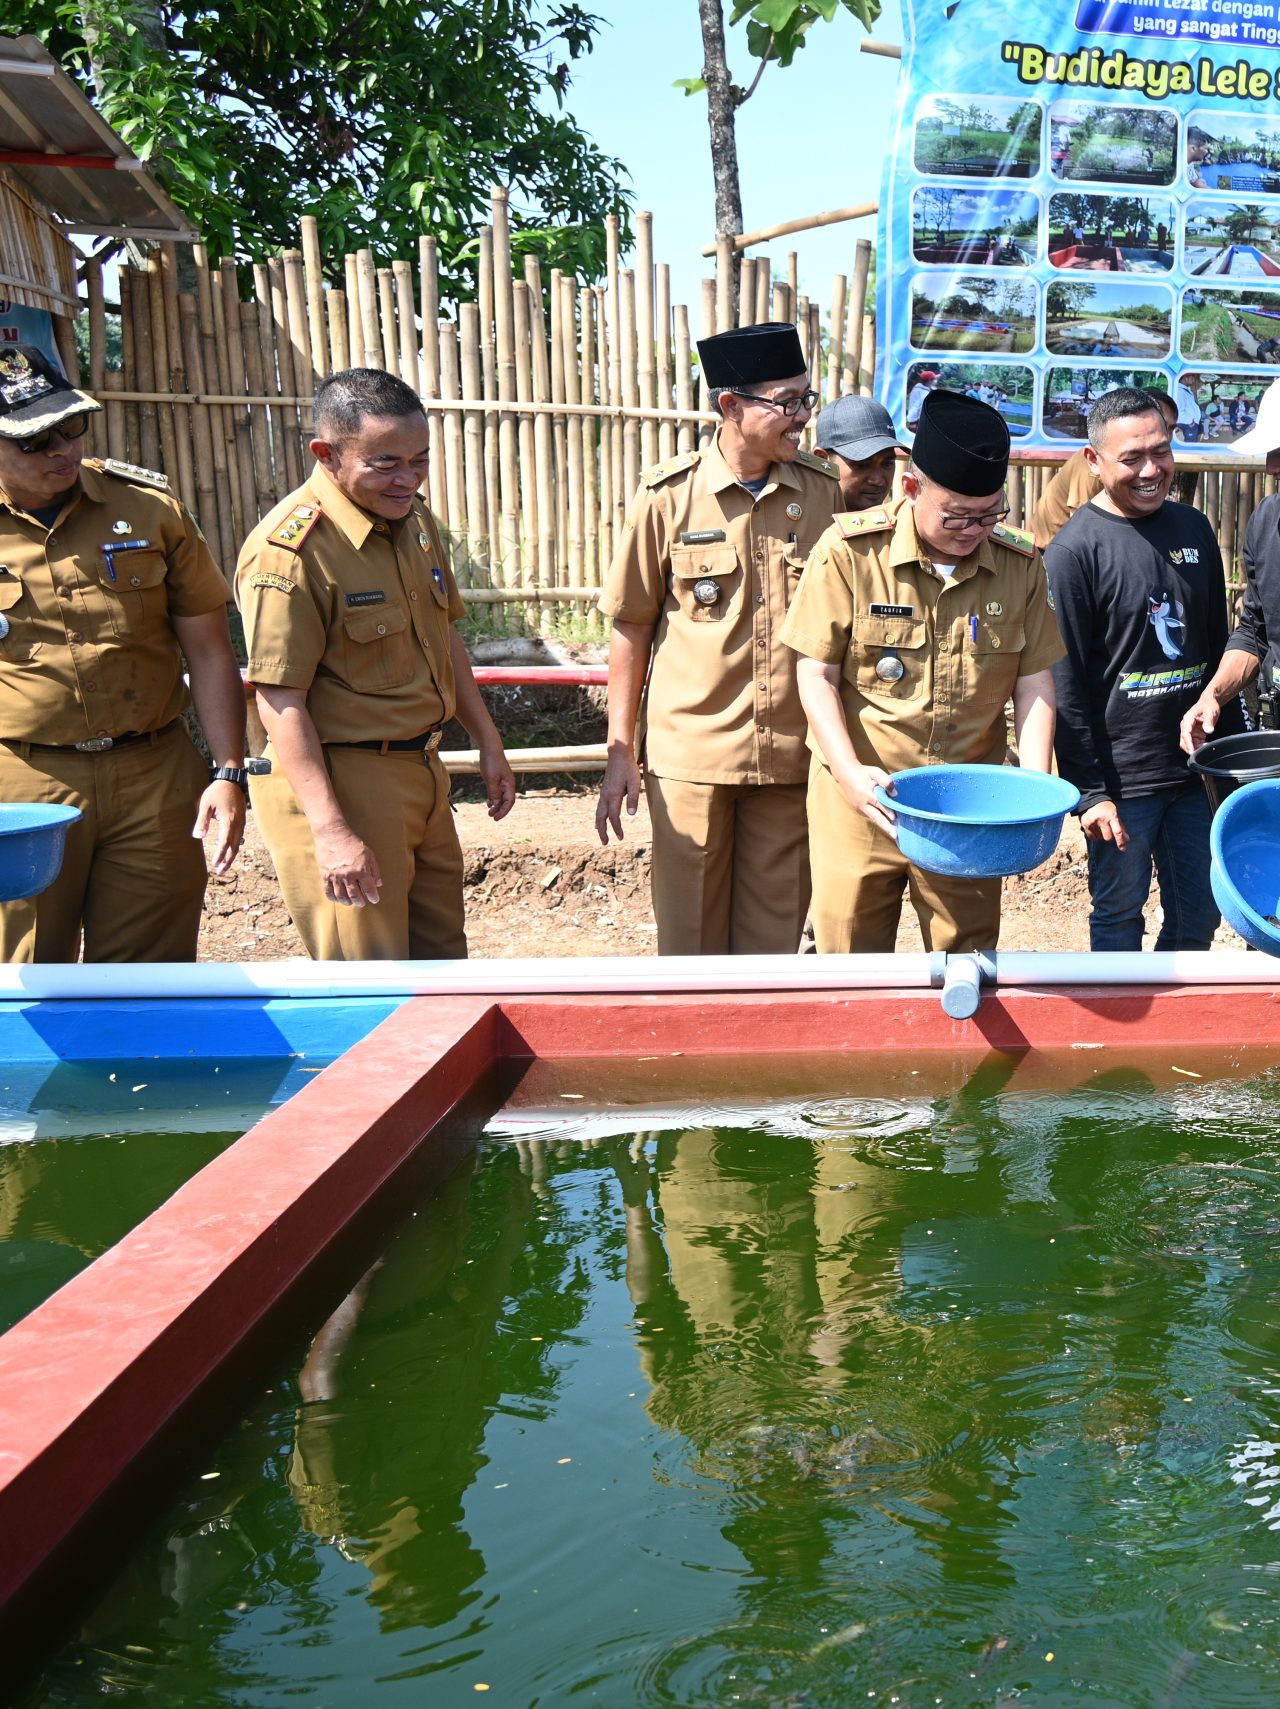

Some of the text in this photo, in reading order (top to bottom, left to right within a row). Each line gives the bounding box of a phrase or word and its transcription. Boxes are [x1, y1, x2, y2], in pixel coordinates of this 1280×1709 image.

[1211, 0, 1274, 19] dengan
[1133, 16, 1177, 34] yang
[1180, 20, 1237, 39] sangat
[1199, 59, 1272, 98] Lele
[1182, 548, 1199, 556] BUM
[1185, 555, 1199, 563] DES
